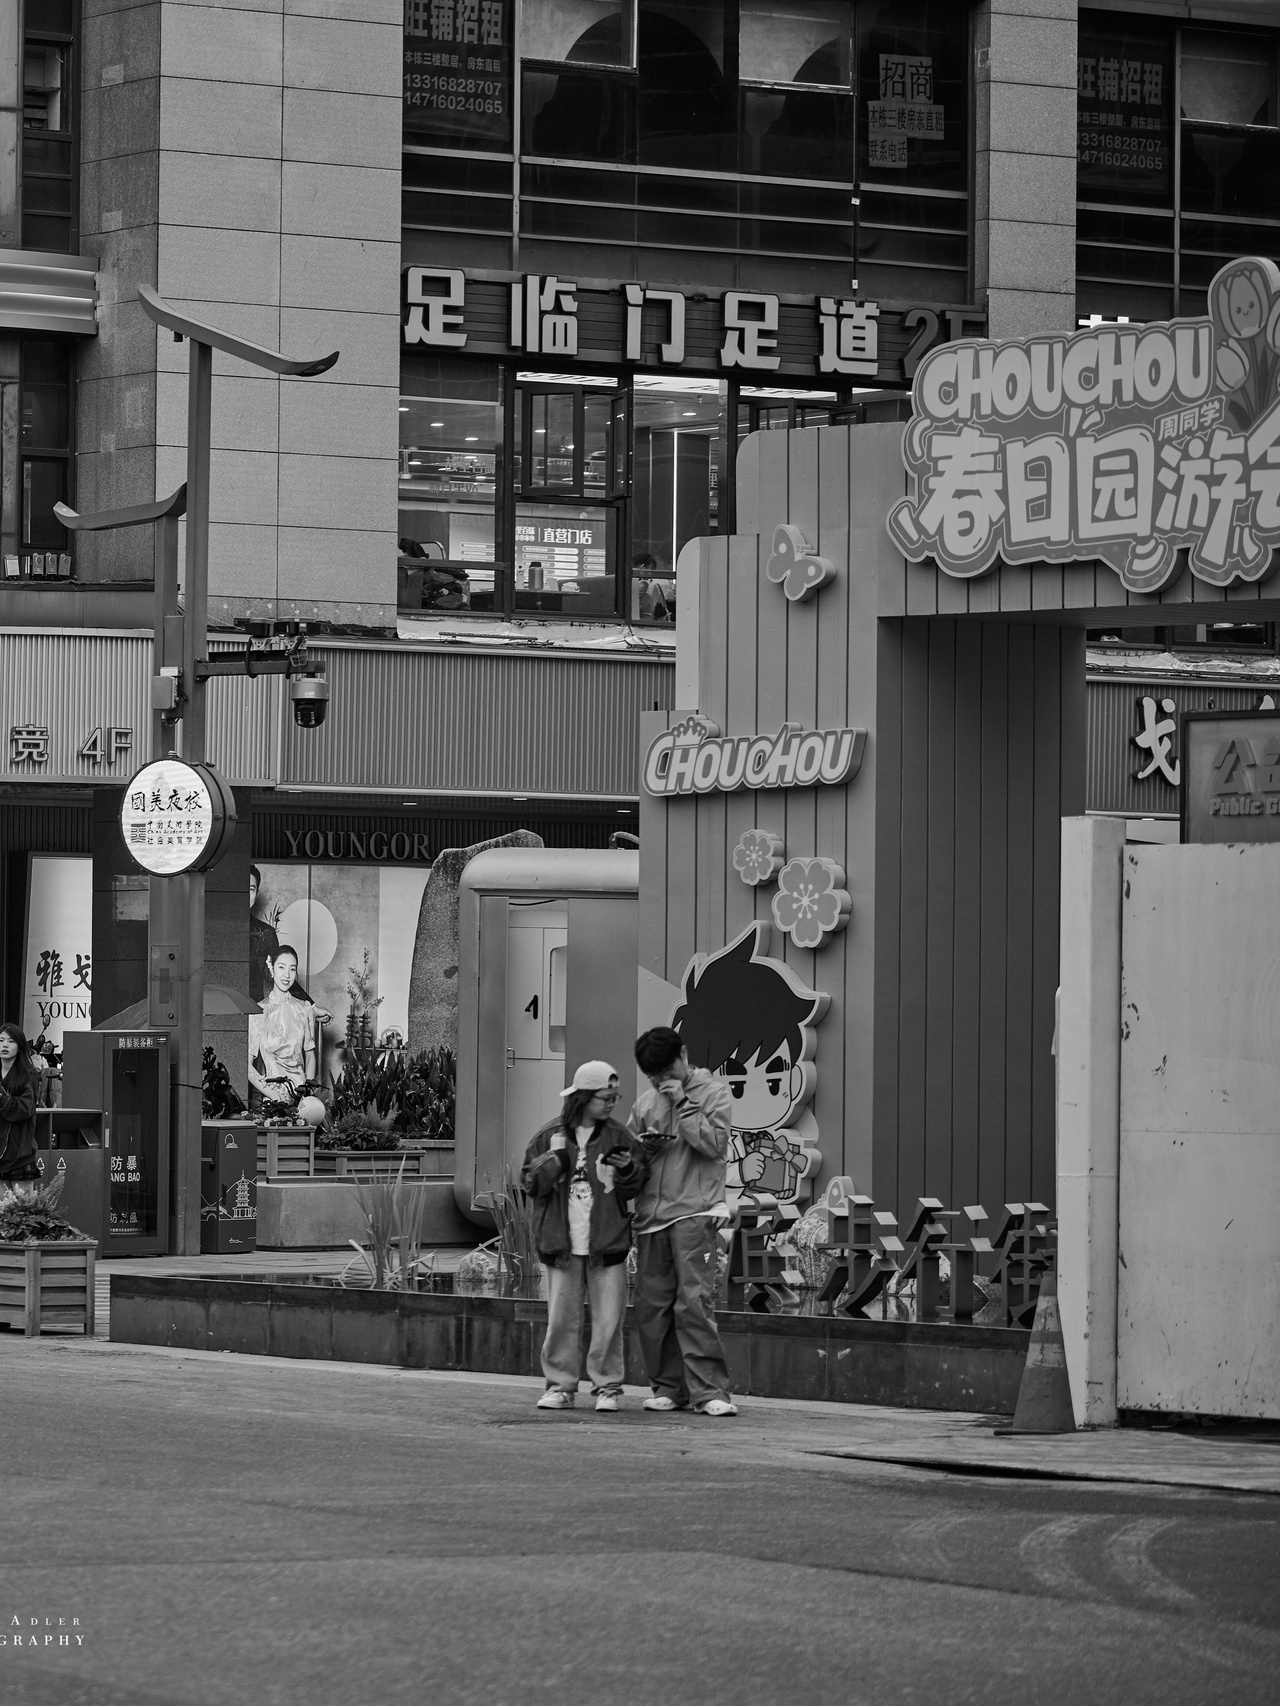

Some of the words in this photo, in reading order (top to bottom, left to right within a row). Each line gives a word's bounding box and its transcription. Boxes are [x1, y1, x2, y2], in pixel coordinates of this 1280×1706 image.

[404, 0, 503, 46] 旺铺招租
[404, 74, 502, 96] 13316828707
[882, 60, 933, 101] 招商
[1077, 57, 1163, 105] 旺铺招租
[404, 92, 503, 114] 14716024065
[870, 106, 944, 133] 本栋三楼房东直租
[870, 140, 907, 163] 联系电话
[404, 266, 881, 375] 足临门足道
[922, 328, 1210, 419] CHOUCHOU
[1158, 400, 1221, 442] 周同学
[543, 527, 593, 545] 直营门店
[79, 726, 134, 764] 4F
[644, 725, 853, 793] CHOUCHOU
[1208, 797, 1263, 816] Public
[1266, 797, 1280, 815] G
[283, 828, 433, 860] YOUNGOR
[110, 1155, 138, 1171] 防暴
